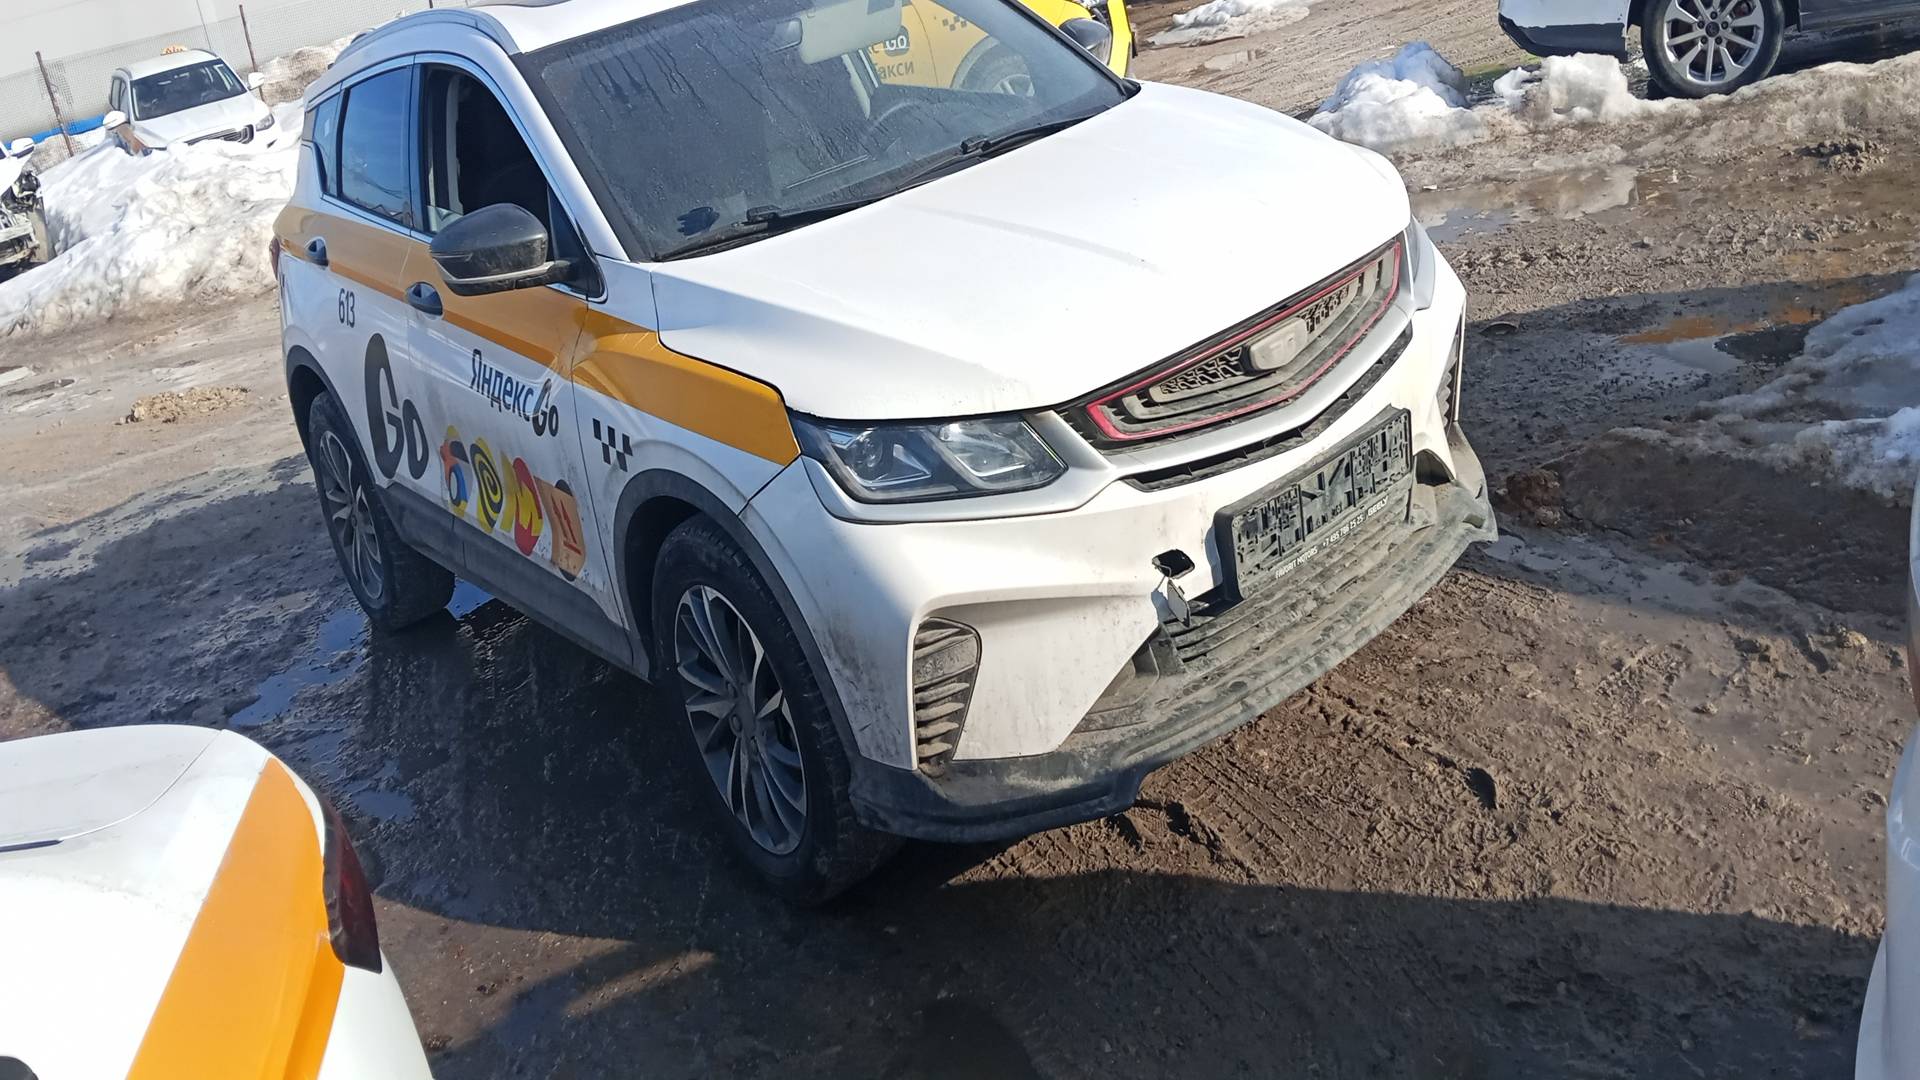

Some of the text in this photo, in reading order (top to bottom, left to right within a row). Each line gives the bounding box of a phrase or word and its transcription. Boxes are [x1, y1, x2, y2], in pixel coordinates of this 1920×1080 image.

[875, 61, 914, 80] акси
[338, 287, 355, 328] 613
[364, 332, 429, 480] Go
[469, 348, 559, 437] Яндекс Go
